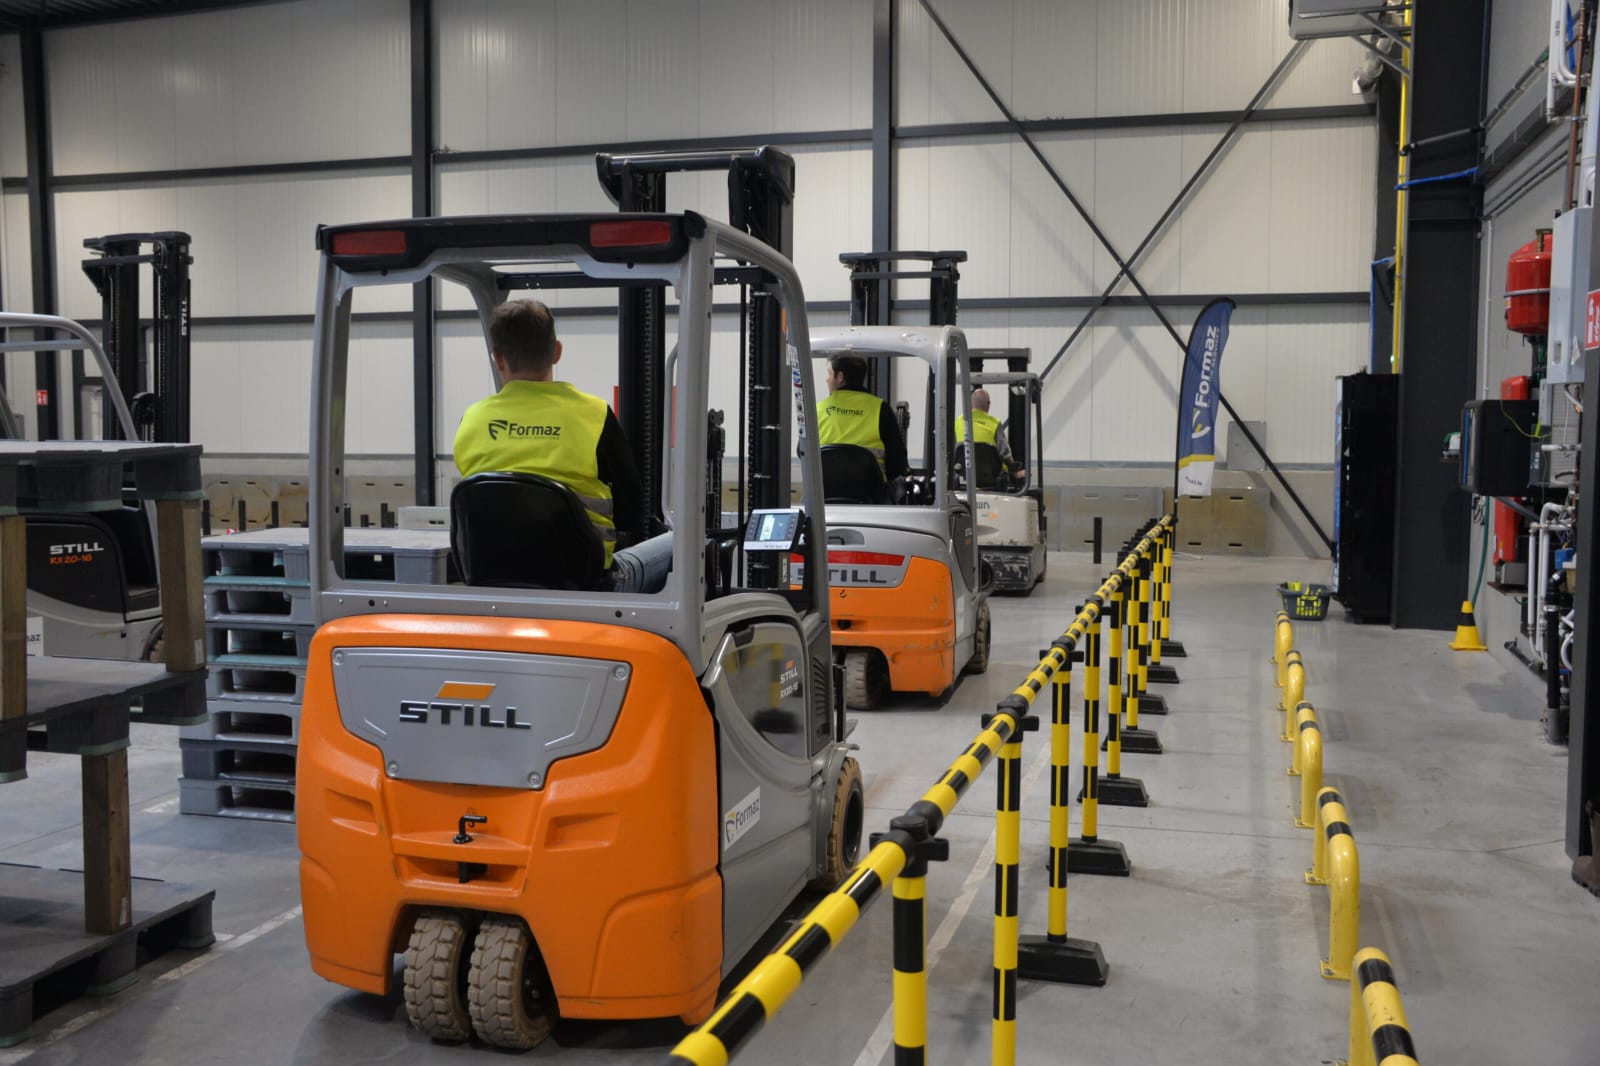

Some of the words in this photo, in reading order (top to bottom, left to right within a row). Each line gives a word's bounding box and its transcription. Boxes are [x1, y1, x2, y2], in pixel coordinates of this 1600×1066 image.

[1195, 325, 1217, 408] Formaz
[836, 407, 865, 416] Formaz
[508, 422, 562, 437] Formaz
[49, 541, 105, 556] STILL
[399, 699, 533, 730] STILL
[735, 798, 760, 831] Formaz
